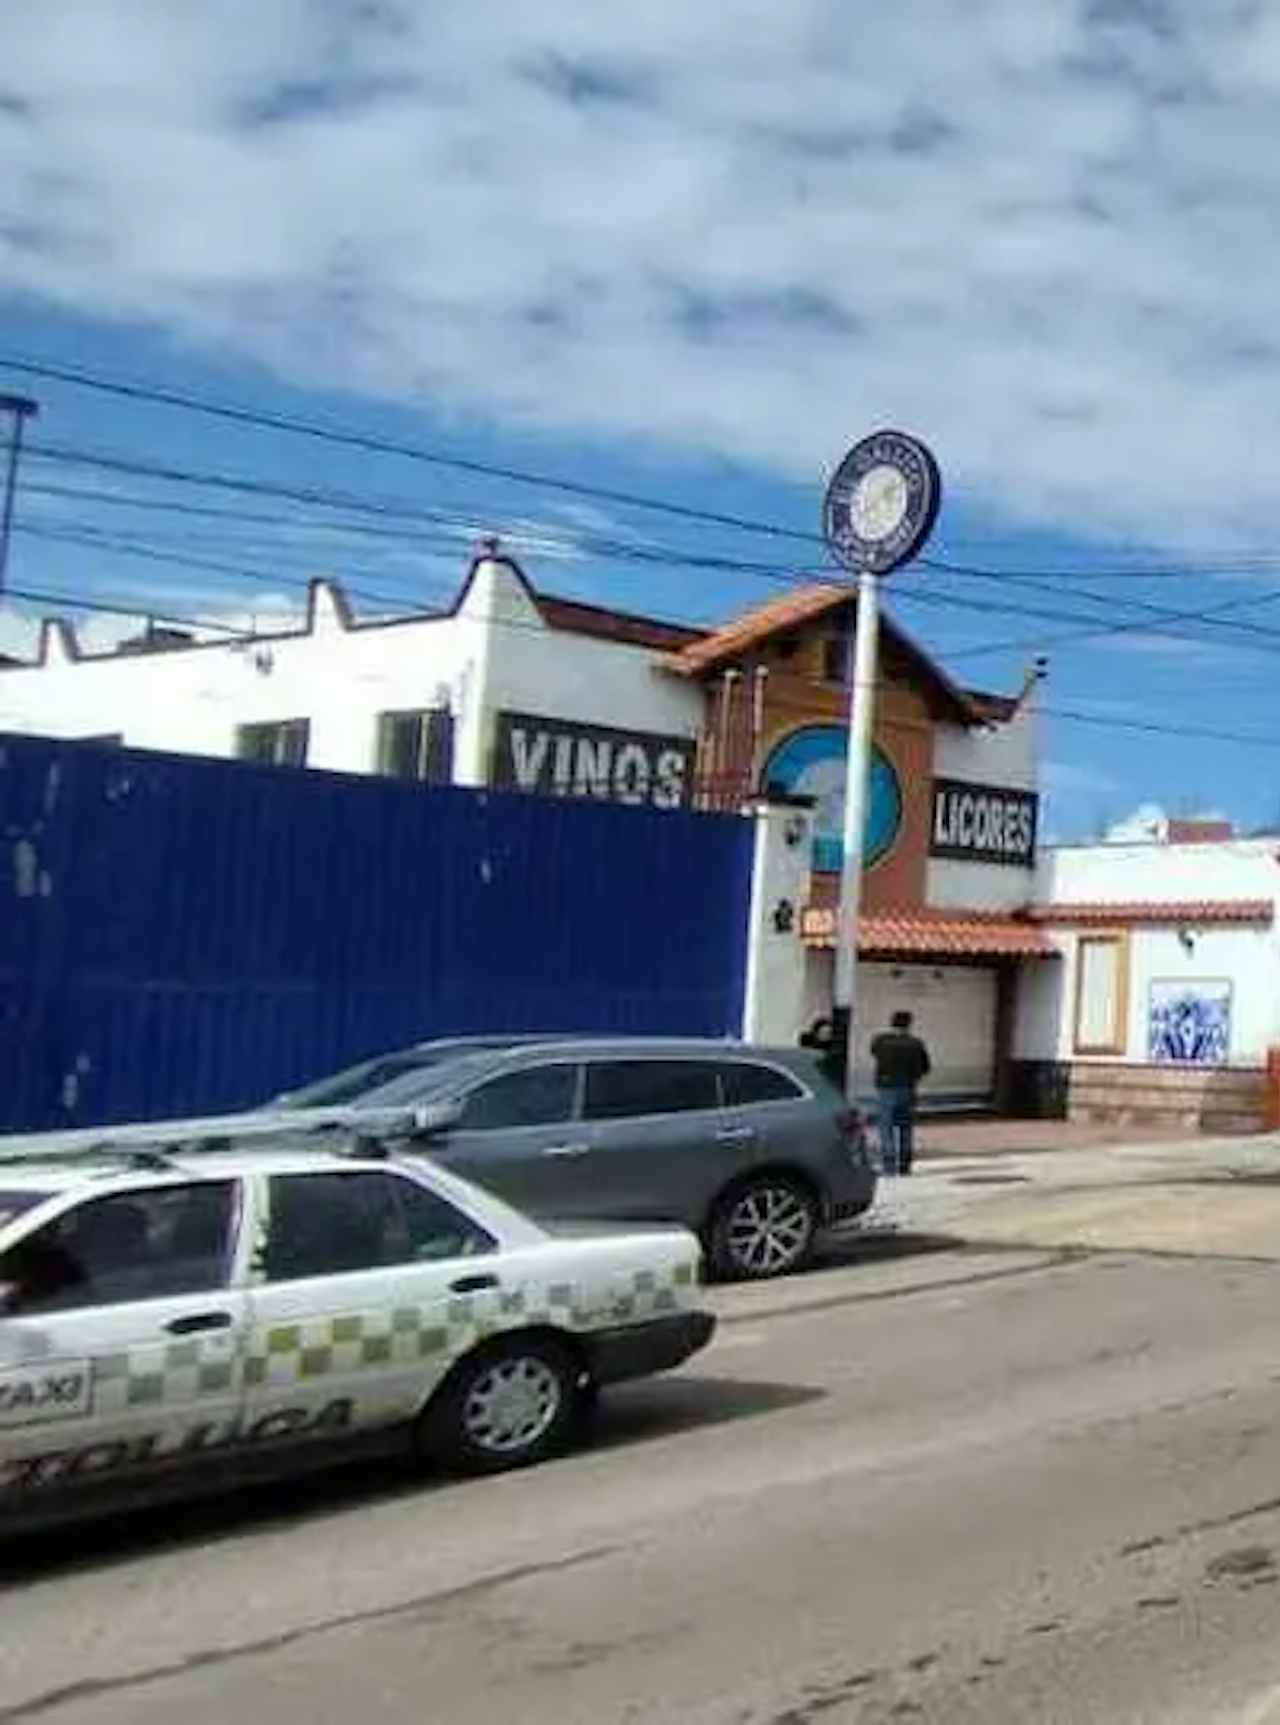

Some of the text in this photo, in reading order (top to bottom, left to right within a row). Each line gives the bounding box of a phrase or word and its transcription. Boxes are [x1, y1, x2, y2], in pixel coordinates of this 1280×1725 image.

[511, 728, 686, 809] VINOS
[935, 791, 1032, 854] LICORES
[12, 1397, 356, 1490] TOLUCA
